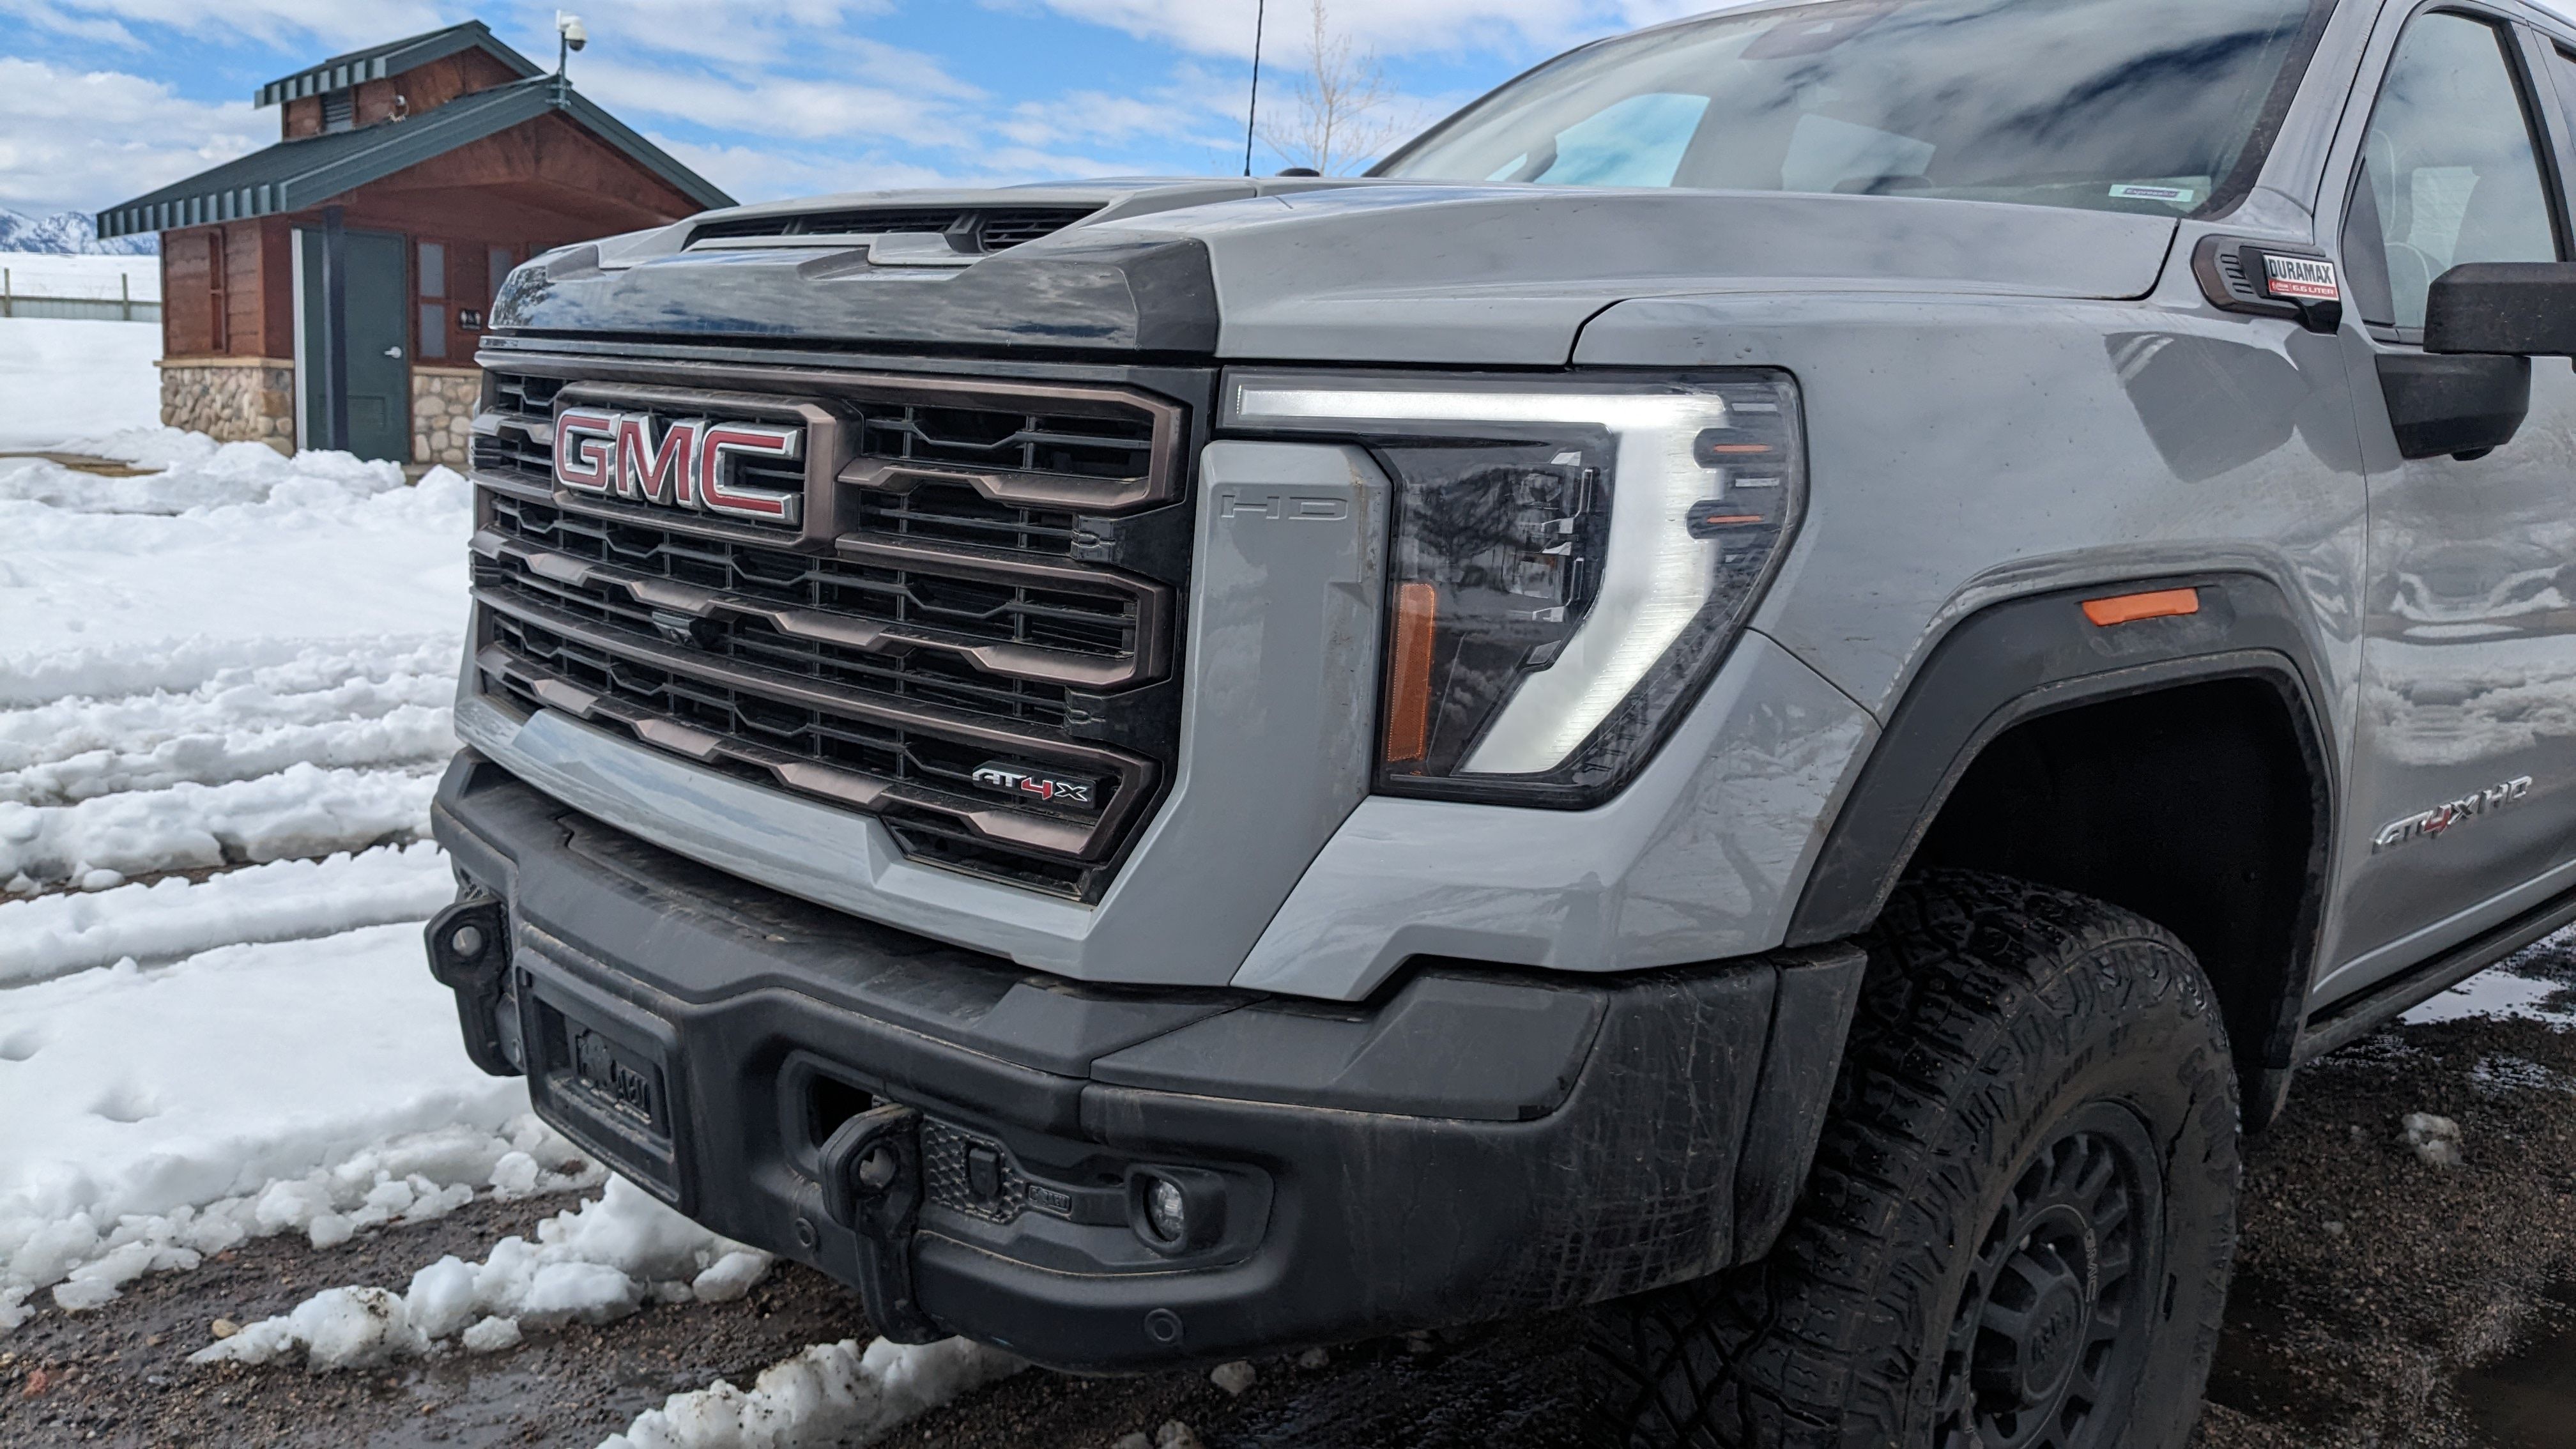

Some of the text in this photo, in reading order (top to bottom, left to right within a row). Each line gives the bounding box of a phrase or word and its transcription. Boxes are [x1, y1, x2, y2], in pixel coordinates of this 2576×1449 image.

[2268, 259, 2333, 284] DURAMAX
[2309, 287, 2334, 295] LITER
[555, 407, 801, 525] GMC
[1221, 494, 1348, 521] HD
[972, 768, 1088, 802] AT4X
